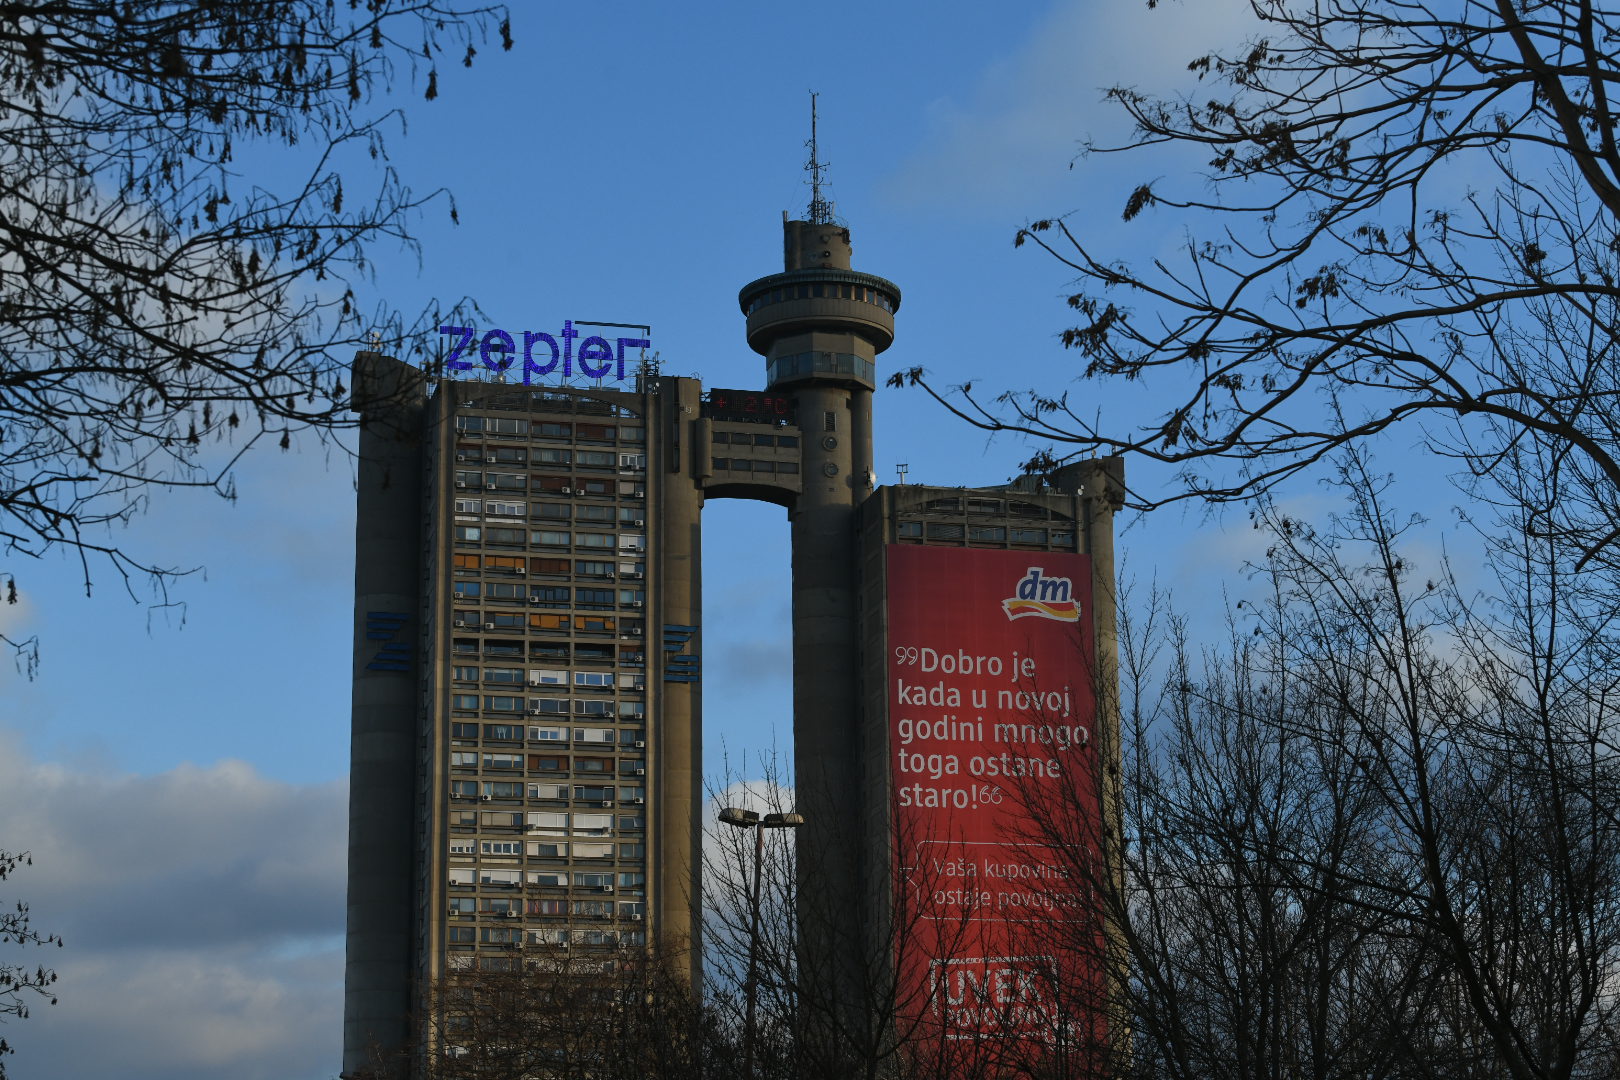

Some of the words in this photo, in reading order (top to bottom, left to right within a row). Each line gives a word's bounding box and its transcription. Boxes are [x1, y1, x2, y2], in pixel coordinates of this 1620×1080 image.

[440, 320, 650, 386] zepter
[1018, 570, 1069, 602] dm
[1011, 651, 1036, 682] je
[898, 678, 961, 707] kada
[972, 689, 987, 709] u
[998, 686, 1070, 718] novoj
[898, 714, 983, 745] godini
[994, 723, 1089, 751] mnogo
[898, 748, 959, 780] toga
[969, 752, 1062, 778] ostane
[933, 858, 977, 877] Vaša
[984, 859, 1069, 881] kupovina
[934, 887, 991, 910] ostaje
[942, 968, 1042, 1006] UVEK
